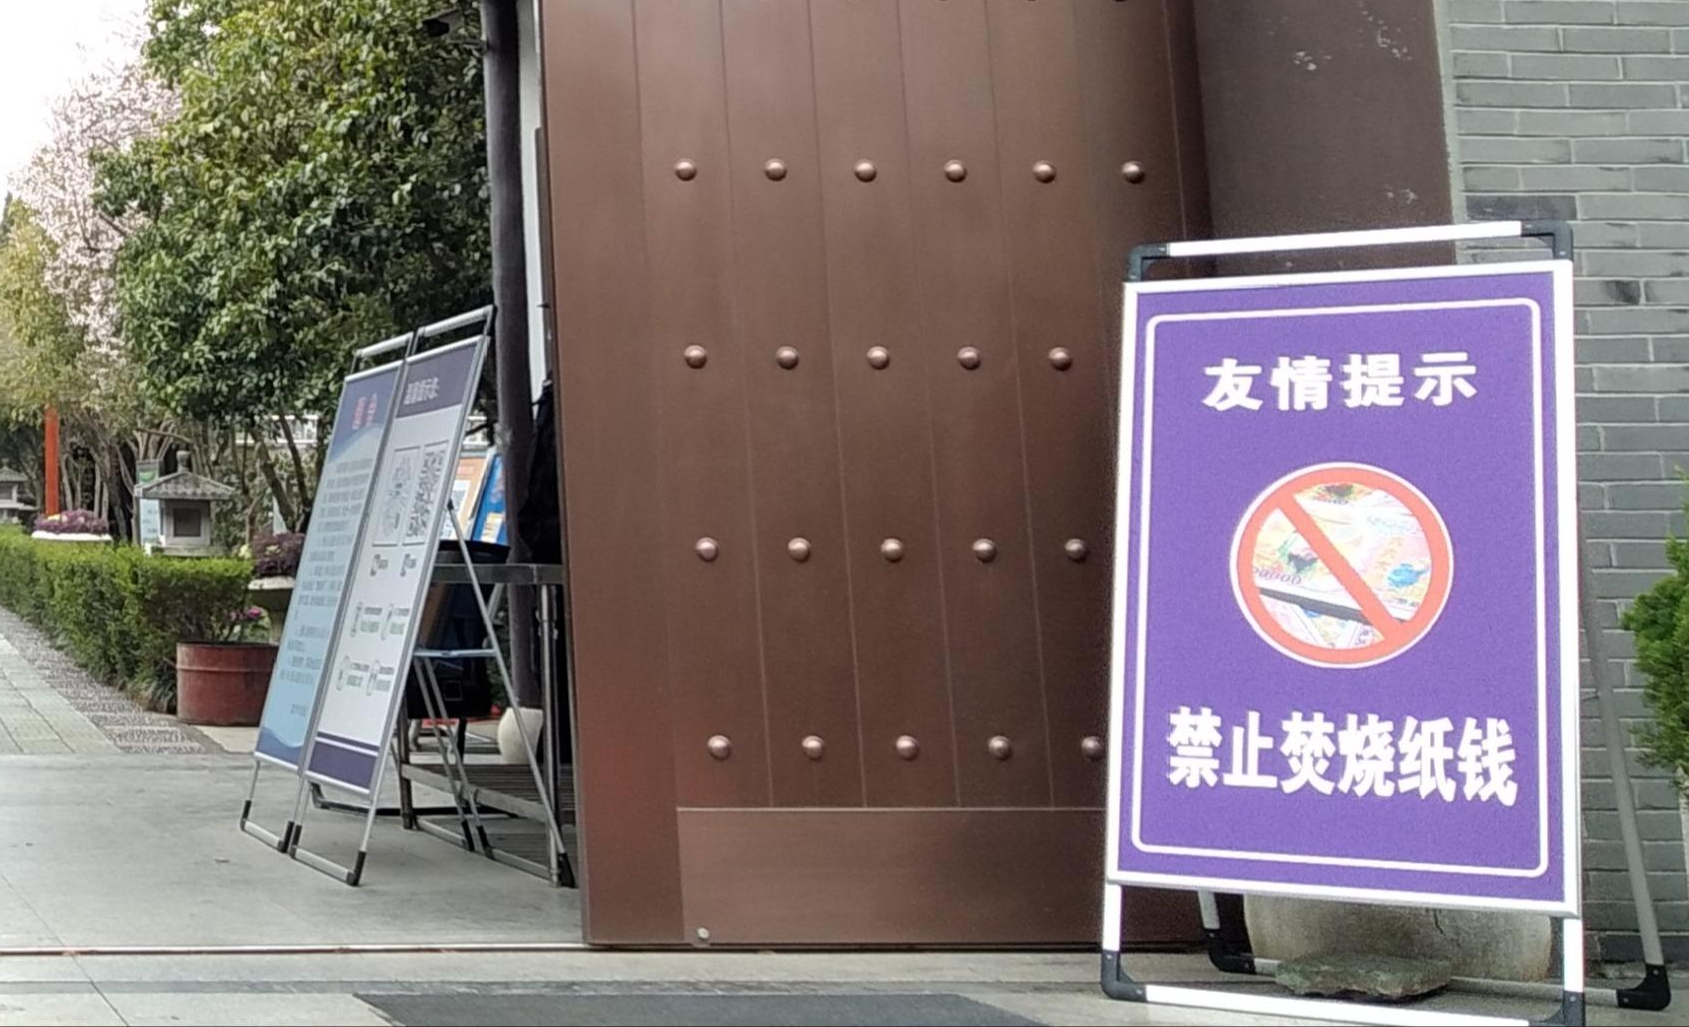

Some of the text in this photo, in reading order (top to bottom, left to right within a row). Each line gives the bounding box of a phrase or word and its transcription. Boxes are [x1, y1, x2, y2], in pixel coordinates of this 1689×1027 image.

[1203, 350, 1479, 412] 友情提示
[1167, 706, 1519, 806] 禁止焚烧纸钱
